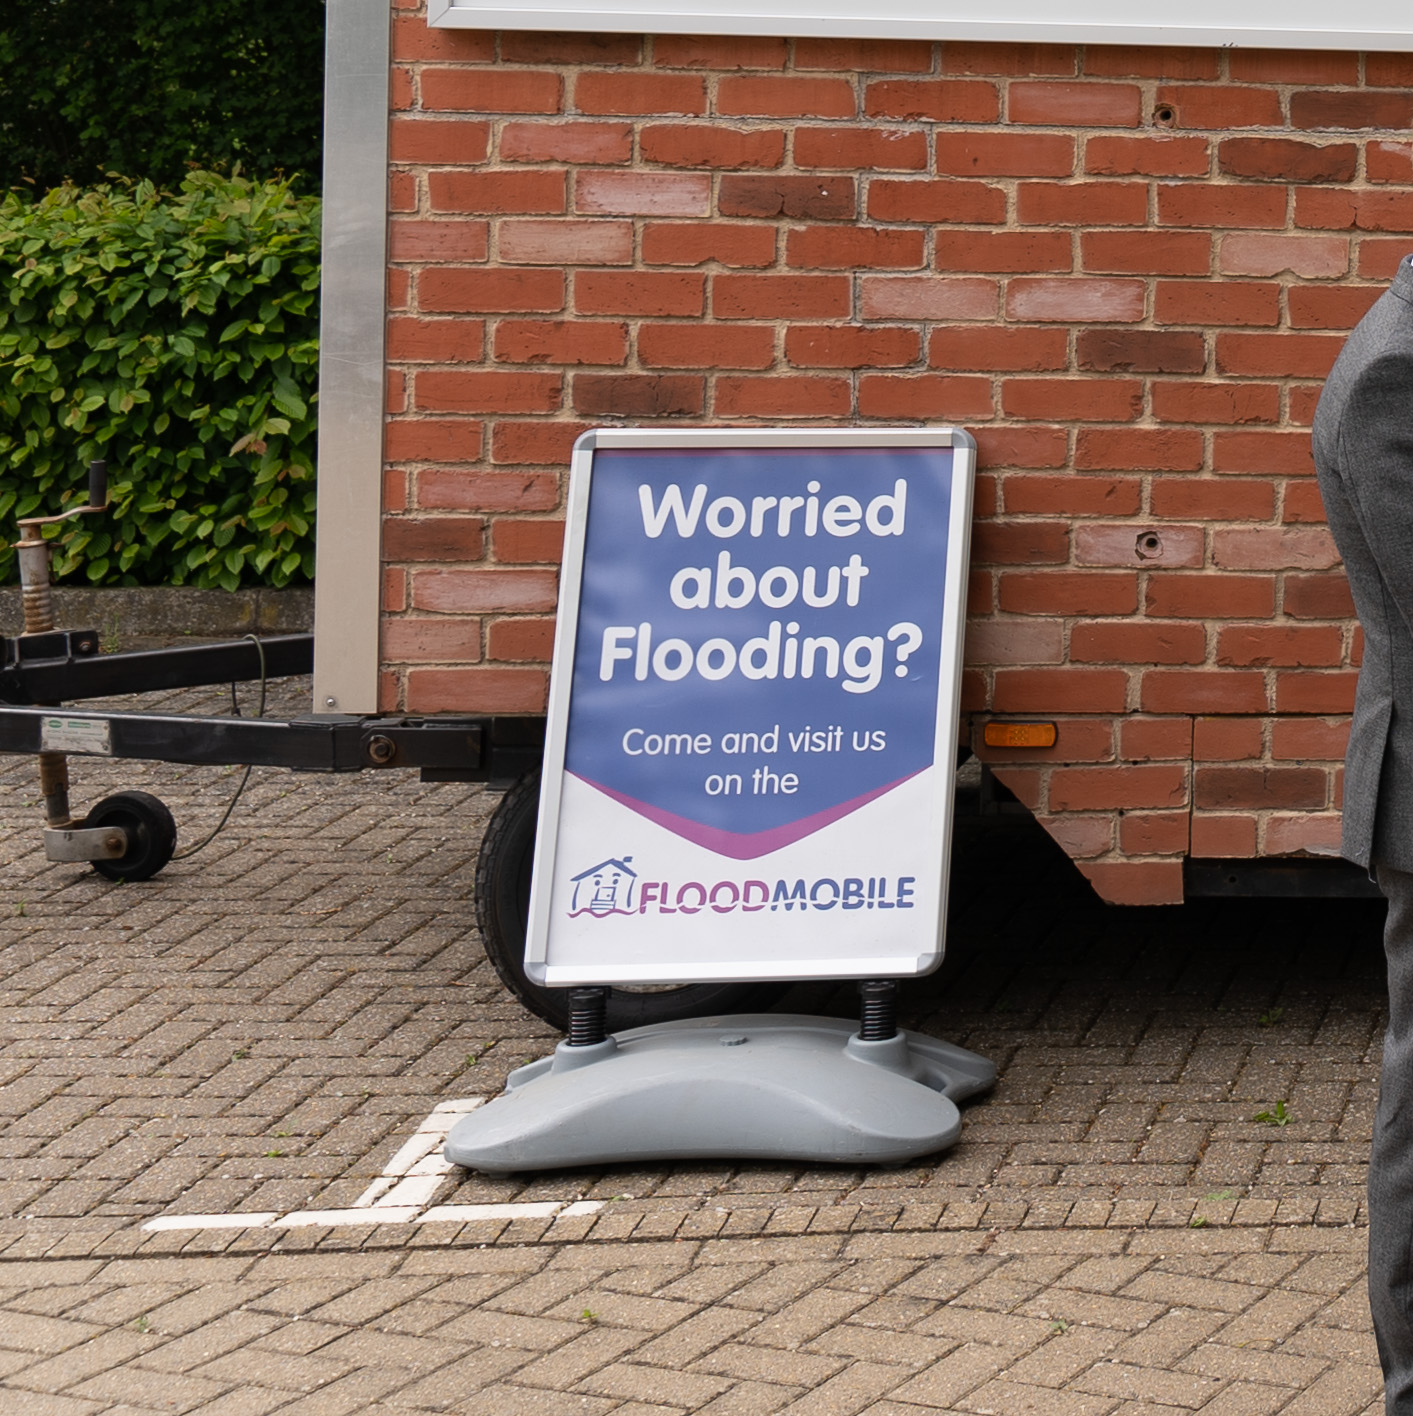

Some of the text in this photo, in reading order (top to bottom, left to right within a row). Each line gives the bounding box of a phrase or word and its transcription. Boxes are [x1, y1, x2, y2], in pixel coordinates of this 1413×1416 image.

[638, 478, 908, 539] Worried
[669, 549, 870, 610] about
[599, 620, 924, 694] Flooding?
[621, 724, 887, 756] Come and visit us
[704, 765, 800, 796] on the
[639, 876, 916, 915] FLOODMOBILE
